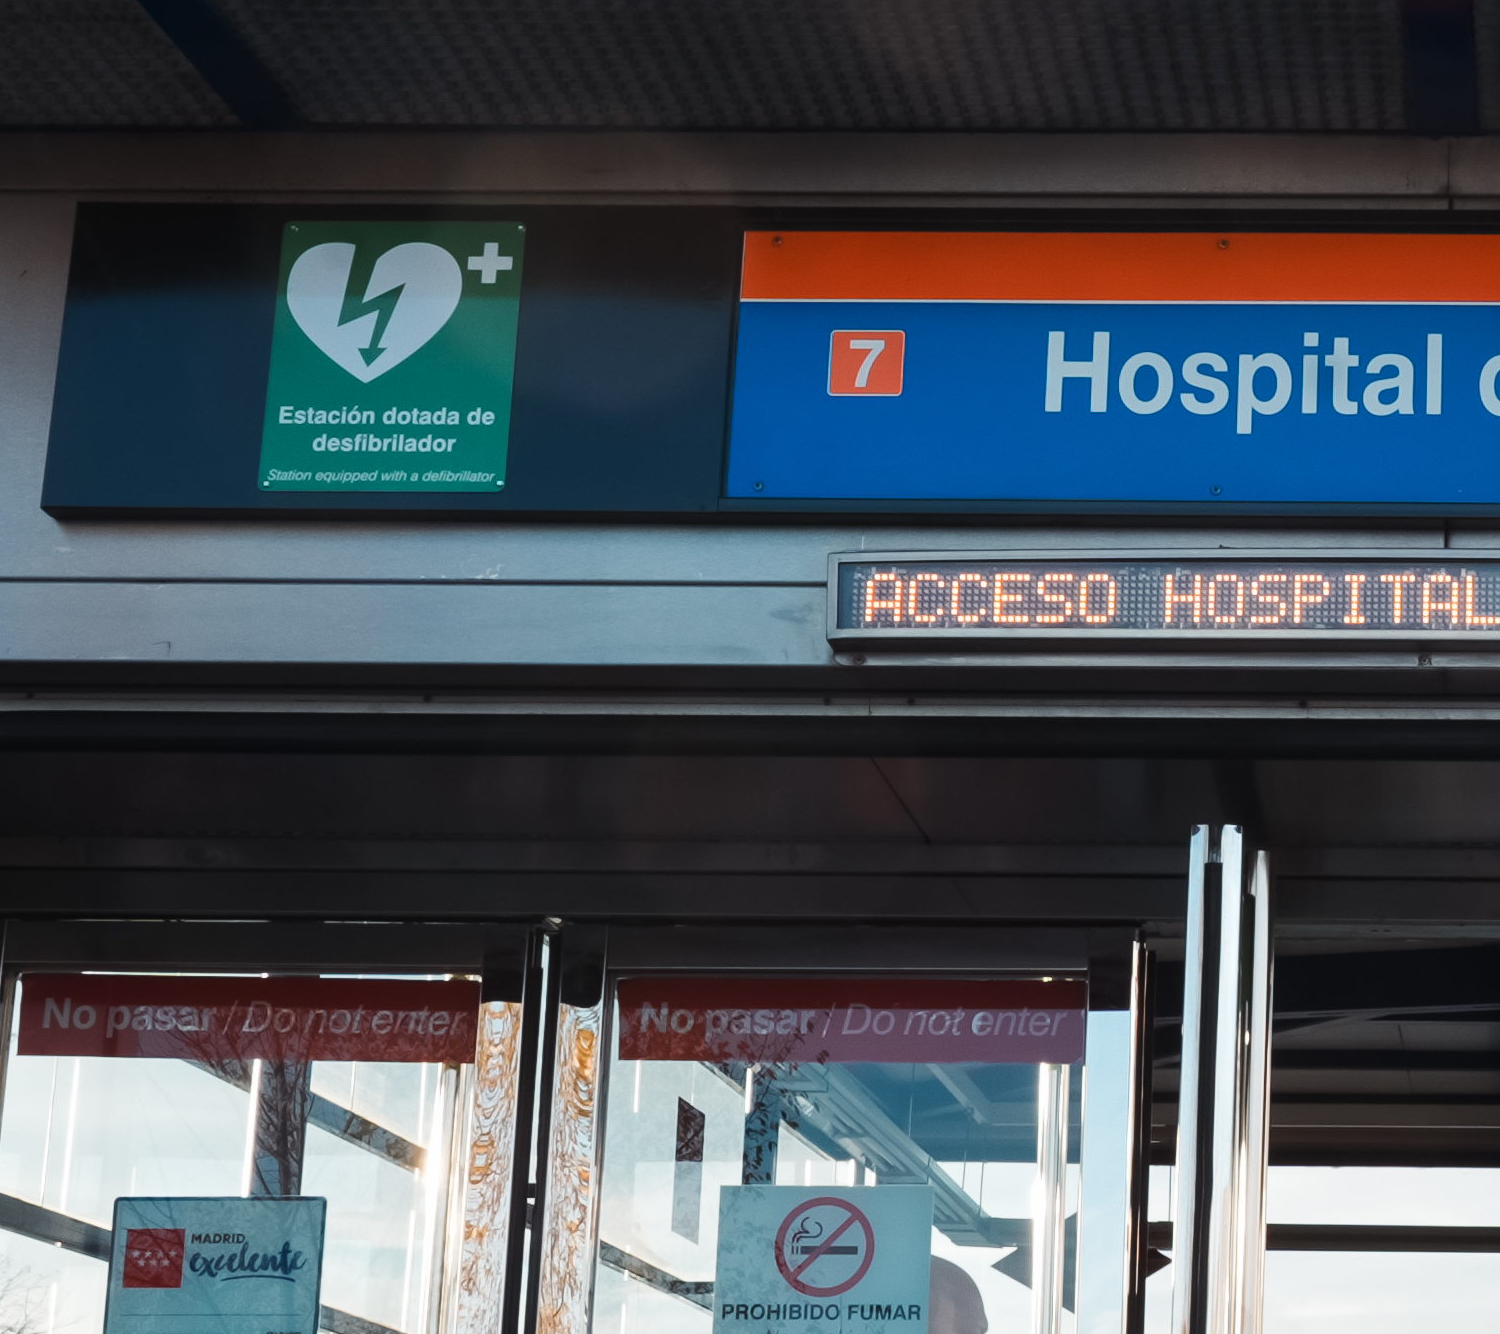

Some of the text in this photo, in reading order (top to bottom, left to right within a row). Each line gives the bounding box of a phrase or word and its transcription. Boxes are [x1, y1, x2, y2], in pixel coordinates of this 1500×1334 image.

[849, 339, 886, 388] 7
[1045, 331, 1443, 434] Hospital
[279, 404, 496, 426] Estación dotada de
[312, 433, 457, 453] desfibrilador
[267, 468, 496, 486] Station equipped with a defibrillator
[864, 573, 1116, 624] ACCESO
[1164, 573, 1500, 626] HOSPITAL
[43, 998, 97, 1029] No
[107, 1004, 217, 1038] pasar
[242, 1000, 298, 1033] Do
[305, 1006, 364, 1034] not
[370, 1007, 467, 1036] enter
[640, 1002, 694, 1034] No
[705, 1007, 815, 1042] pasar
[841, 1003, 896, 1036] Do
[904, 1006, 962, 1036] not
[971, 1007, 1067, 1036] enter
[191, 1233, 246, 1244] MADRID
[190, 1241, 307, 1278] excelente
[721, 1303, 921, 1321] PROHIBIDO FUMAR
